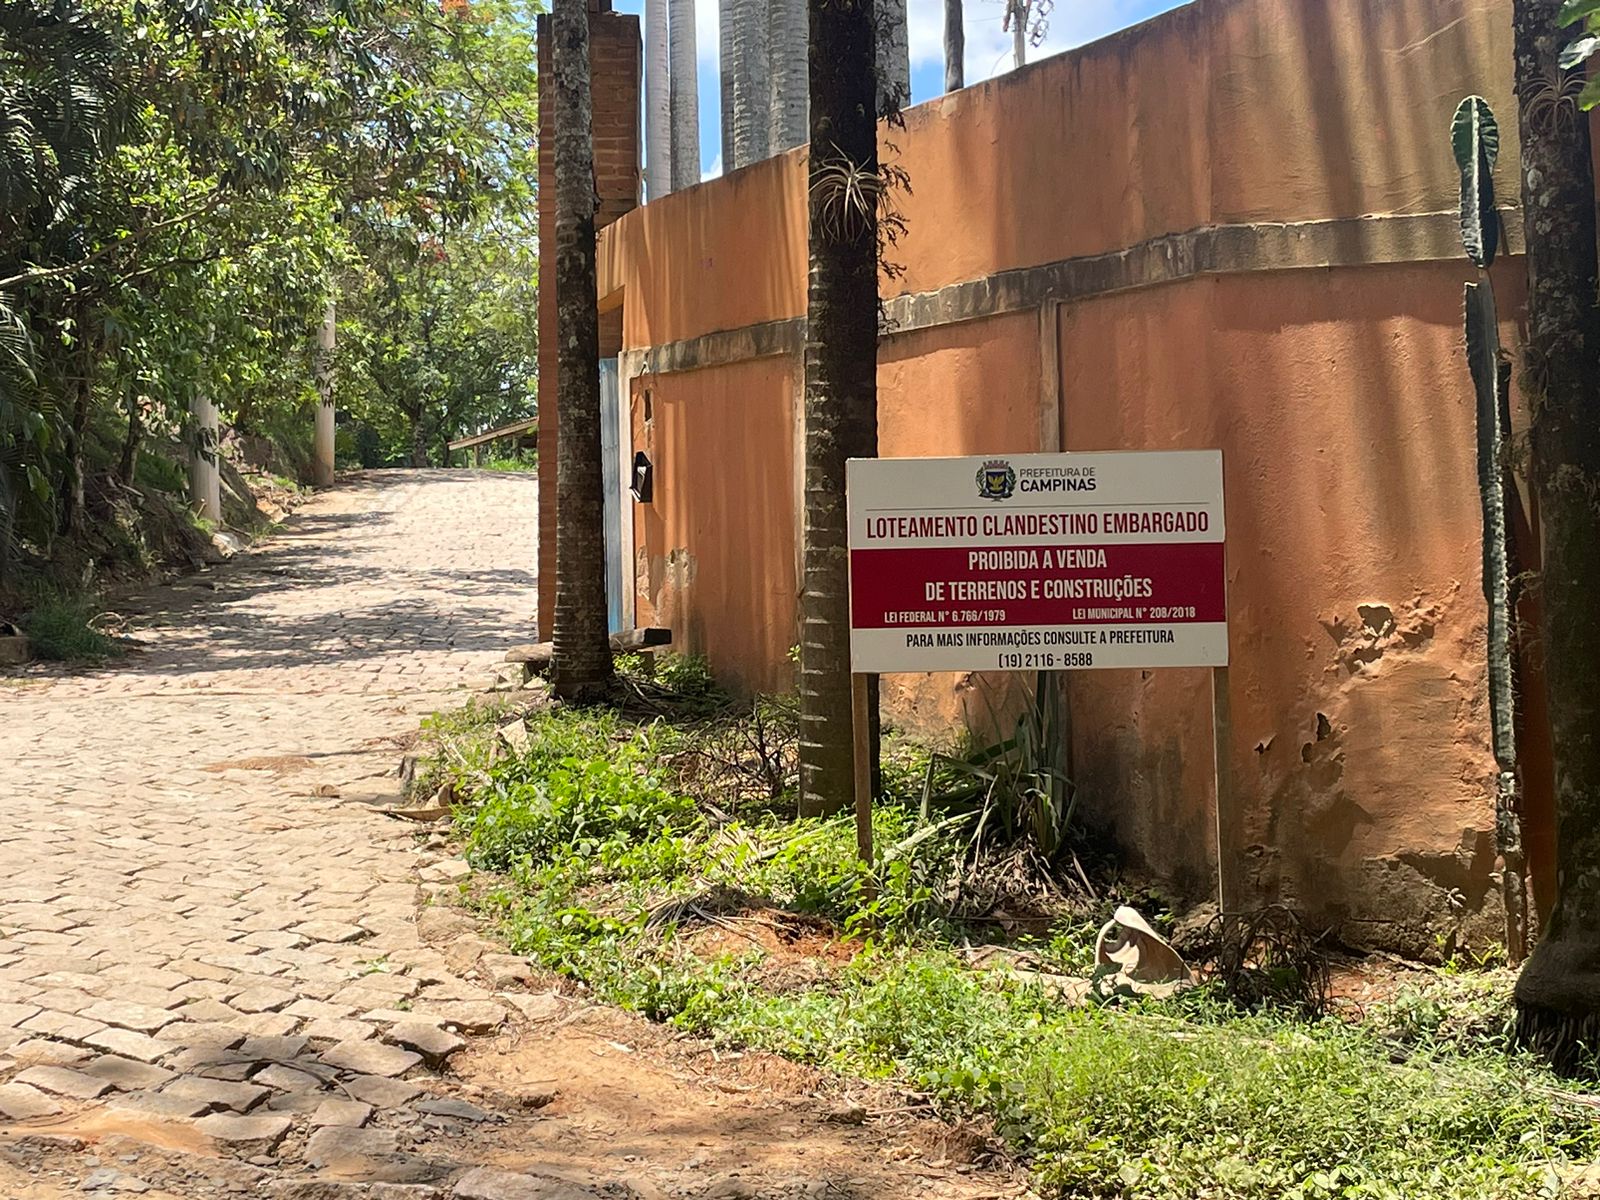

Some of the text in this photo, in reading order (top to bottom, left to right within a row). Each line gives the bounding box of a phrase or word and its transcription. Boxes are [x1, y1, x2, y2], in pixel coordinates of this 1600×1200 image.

[1020, 466, 1096, 478] PREFEITURA DE
[1020, 478, 1097, 492] CAMPINAS
[867, 511, 1209, 539] LOTEAMENTO CLANDESTINO EMBARGADO
[968, 549, 1107, 570] PROIBIDA A VENDA
[925, 575, 1152, 601] DE TERRENOS E CONSTRUÇÕES
[884, 612, 898, 624] LEI
[900, 611, 936, 622] FEDERAL
[952, 610, 1006, 622] 6.766/1979
[1072, 608, 1086, 620] LEI
[1088, 607, 1134, 620] MUNICIPAL
[1150, 606, 1196, 618] 208/2018
[906, 630, 1174, 648] PARA MAIS INFORMAÇÕES CONSULTE A PREFEITURA
[998, 654, 1022, 668] (19)
[1026, 653, 1054, 668] 2116
[1064, 652, 1093, 666] 8588
